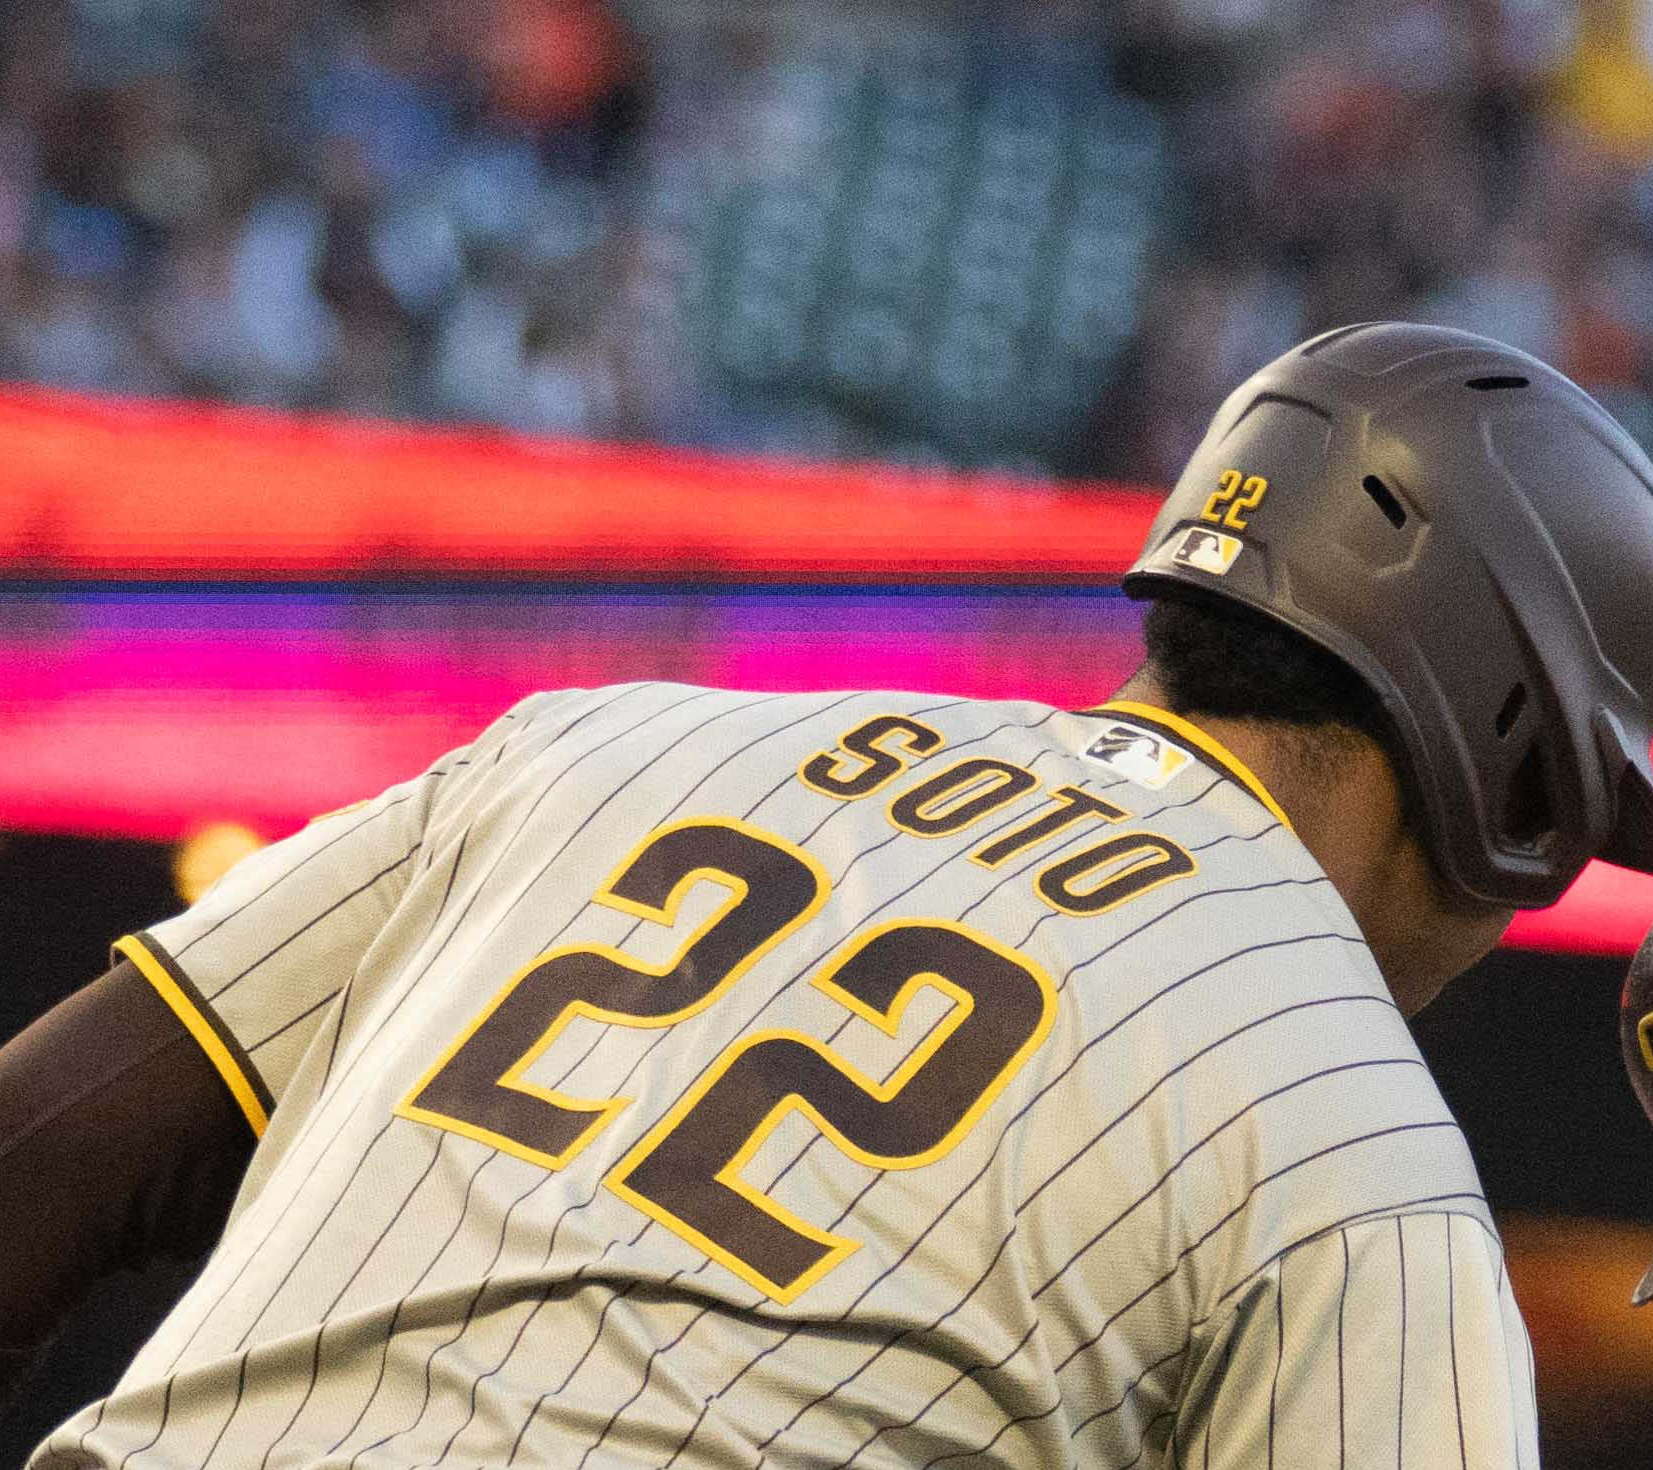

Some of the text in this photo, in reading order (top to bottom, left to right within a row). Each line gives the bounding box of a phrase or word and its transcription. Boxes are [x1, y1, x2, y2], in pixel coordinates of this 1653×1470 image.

[1200, 469, 1268, 530] 22
[797, 711, 1199, 918] SOTO
[393, 812, 1060, 1307] 22
